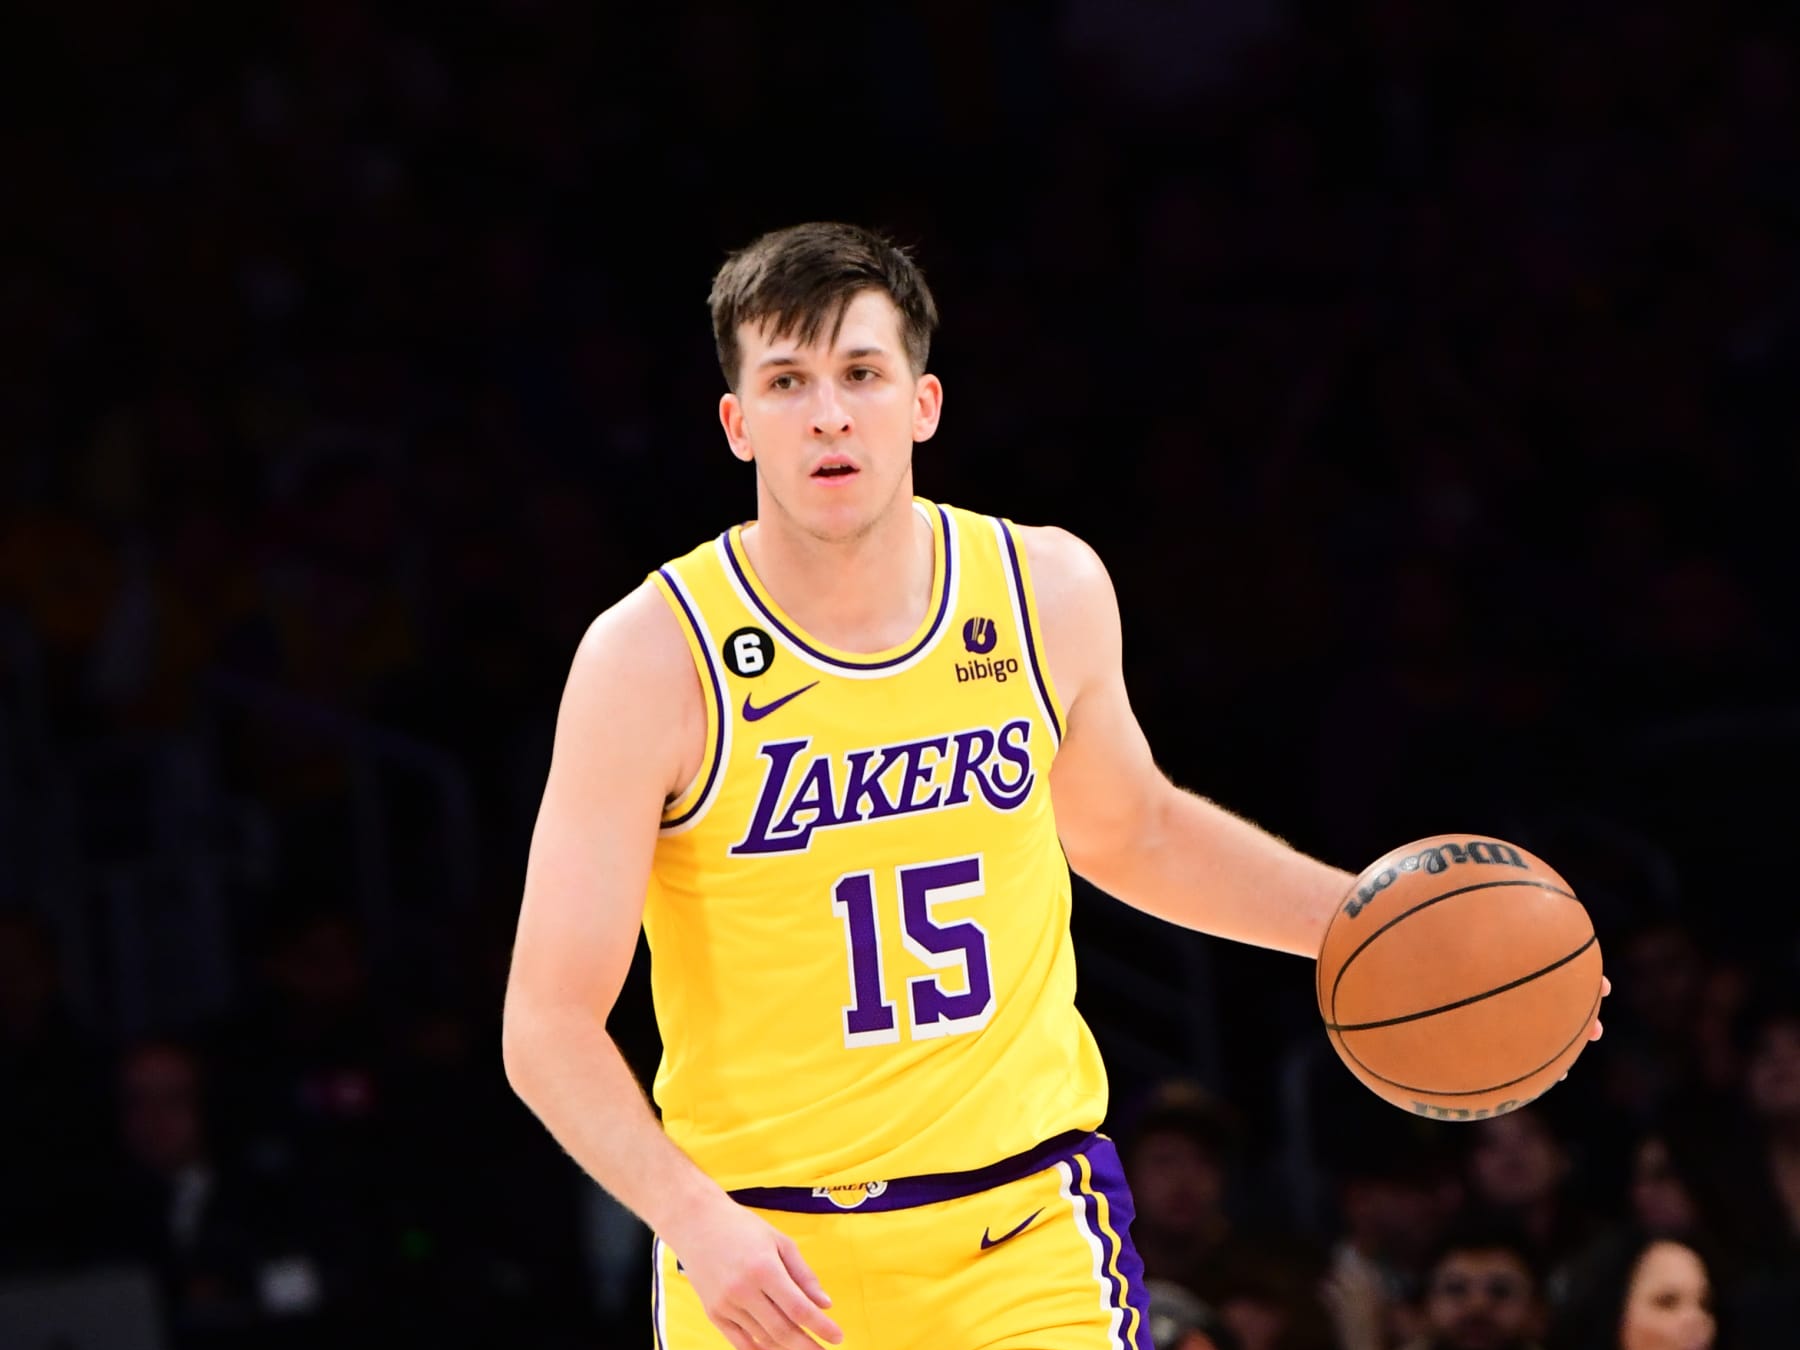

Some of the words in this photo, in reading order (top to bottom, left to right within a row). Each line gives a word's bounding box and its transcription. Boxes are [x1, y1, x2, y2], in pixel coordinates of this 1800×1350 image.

[733, 632, 765, 674] 6
[954, 657, 1019, 683] bibigo
[728, 718, 1035, 857] LAKERS
[1343, 841, 1529, 920] Wilson
[832, 853, 996, 1048] 15
